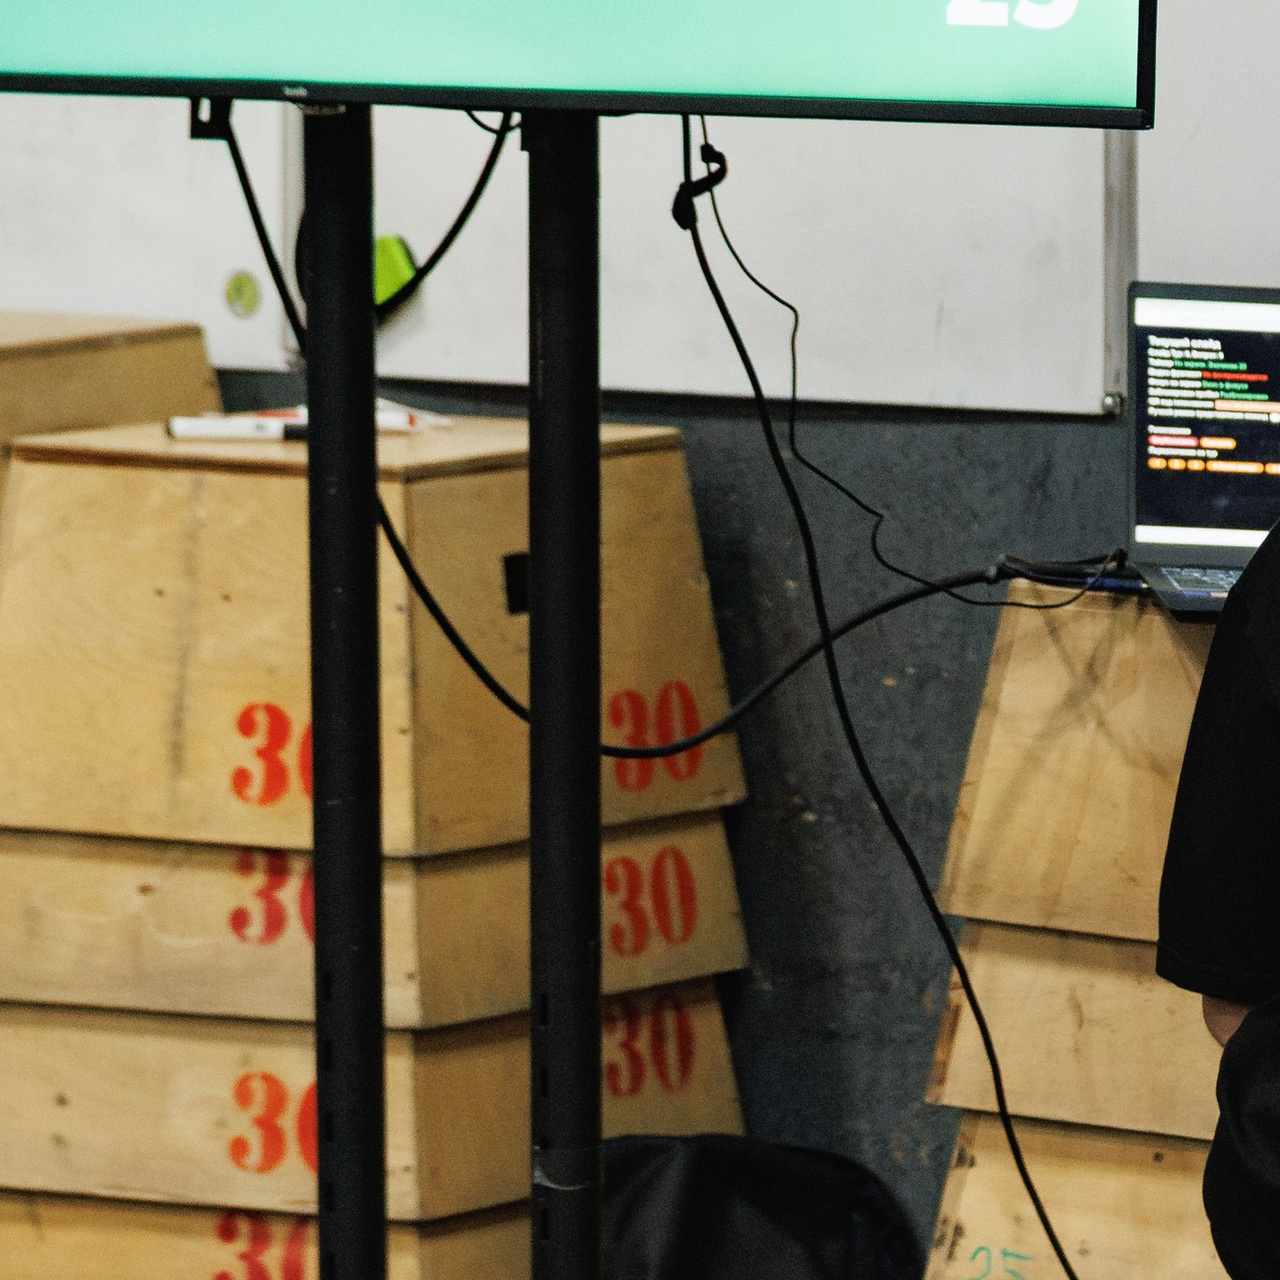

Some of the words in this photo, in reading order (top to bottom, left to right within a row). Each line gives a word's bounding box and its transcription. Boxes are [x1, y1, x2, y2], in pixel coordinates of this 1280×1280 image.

[230, 702, 313, 806] 3
[609, 680, 707, 792] 30
[605, 844, 698, 958] 30
[603, 995, 695, 1099] 30
